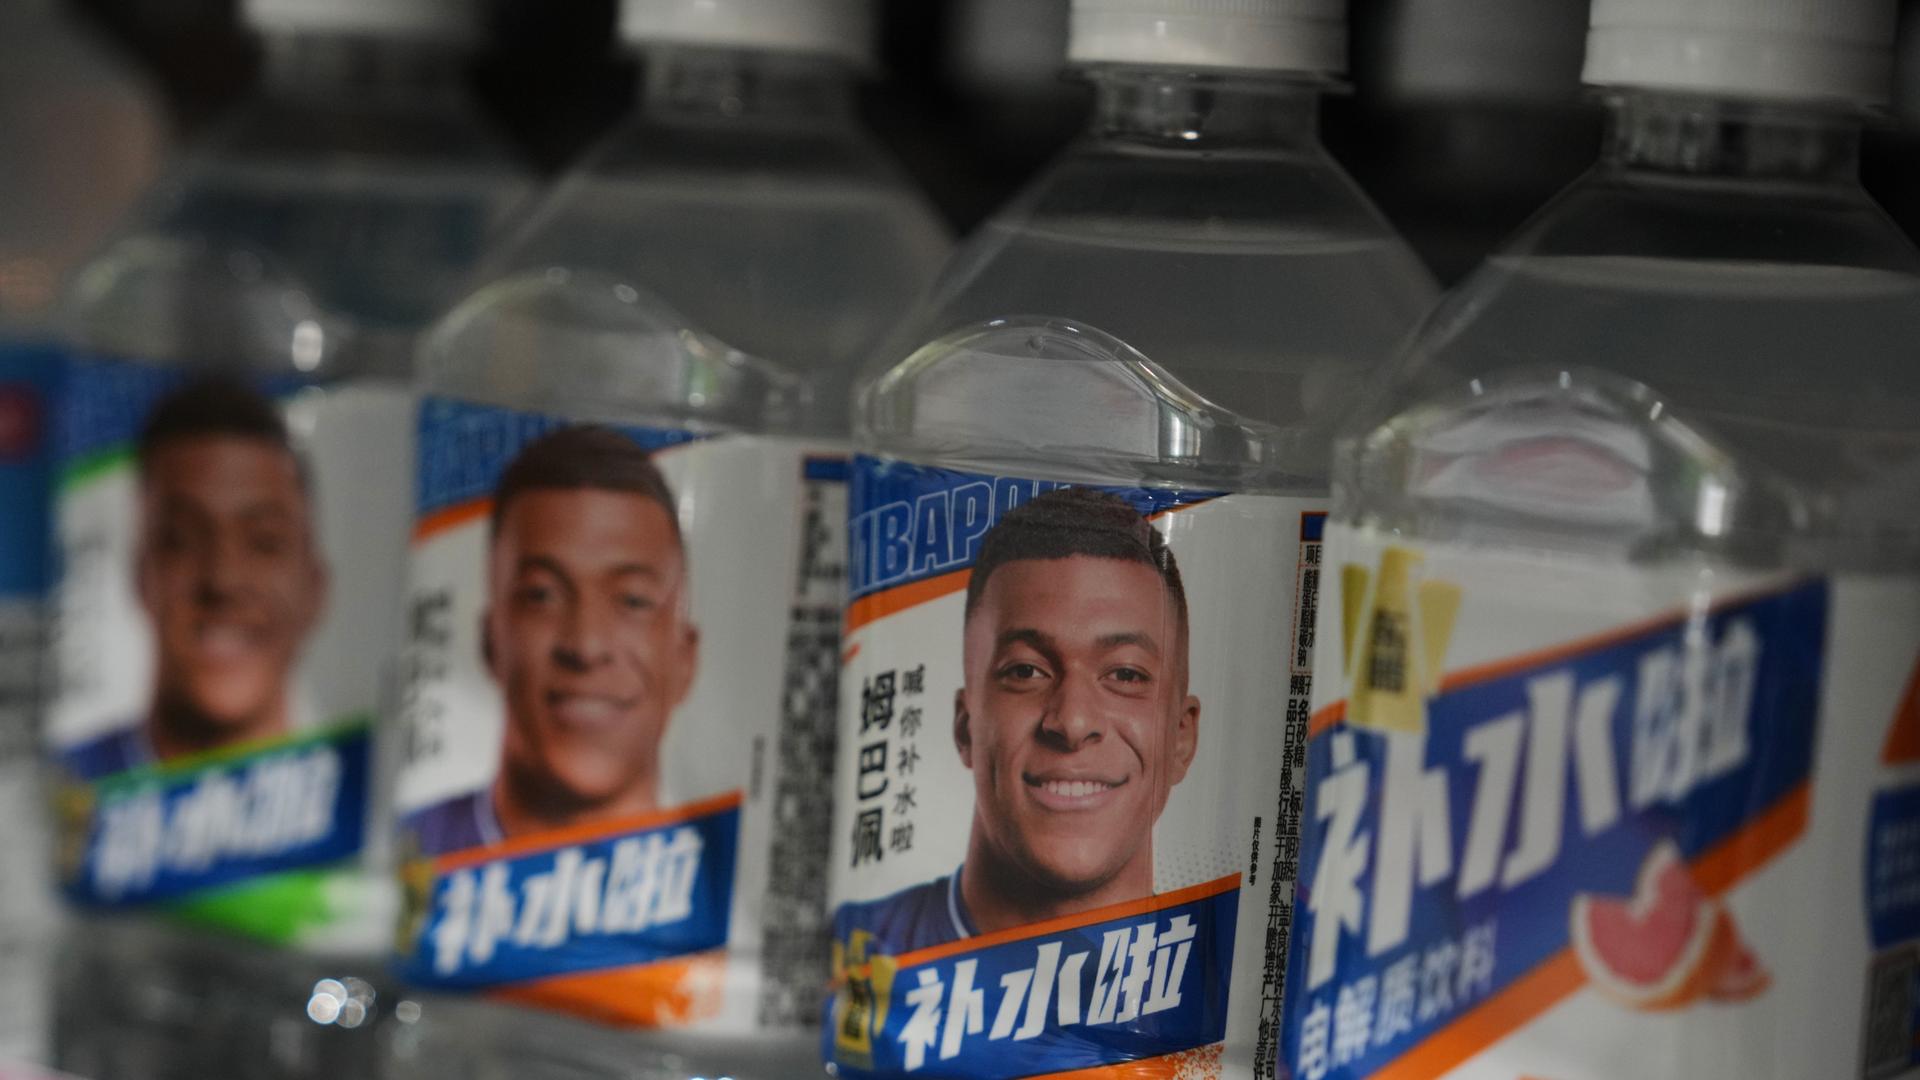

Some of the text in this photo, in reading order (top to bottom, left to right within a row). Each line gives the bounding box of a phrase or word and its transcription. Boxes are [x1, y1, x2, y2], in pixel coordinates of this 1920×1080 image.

[850, 670, 896, 868] 姆巴佩
[889, 663, 925, 852] 喊你补水啦
[1307, 616, 1759, 990] 补水啦
[433, 827, 703, 974] 补水啦
[898, 914, 1197, 1072] 补水啦
[1298, 924, 1498, 1080] 电解质饮料
